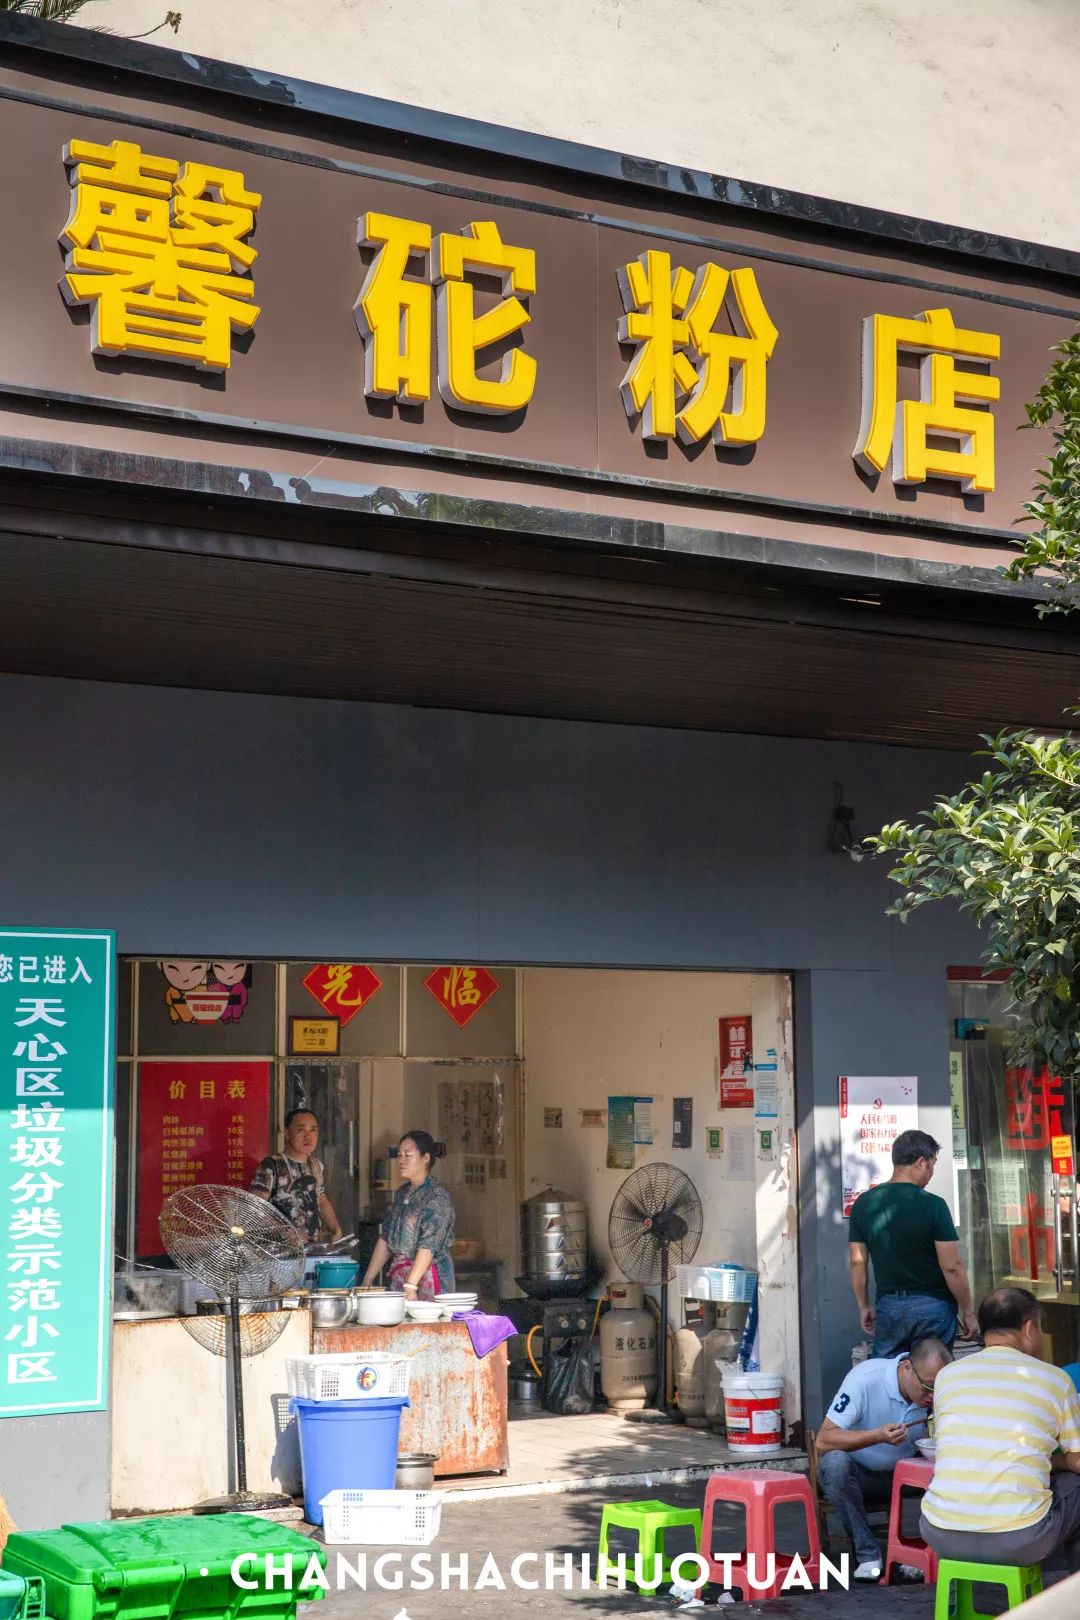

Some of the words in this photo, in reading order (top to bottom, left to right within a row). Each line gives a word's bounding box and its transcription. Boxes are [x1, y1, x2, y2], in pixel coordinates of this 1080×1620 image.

[57, 138, 1001, 495] 馨砣粉店
[321, 965, 362, 1006] 光
[443, 967, 481, 1008] 临
[169, 1080, 246, 1099] 价目表
[5, 997, 68, 1384] 天心区垃圾分类示范小区
[833, 1392, 851, 1414] 3
